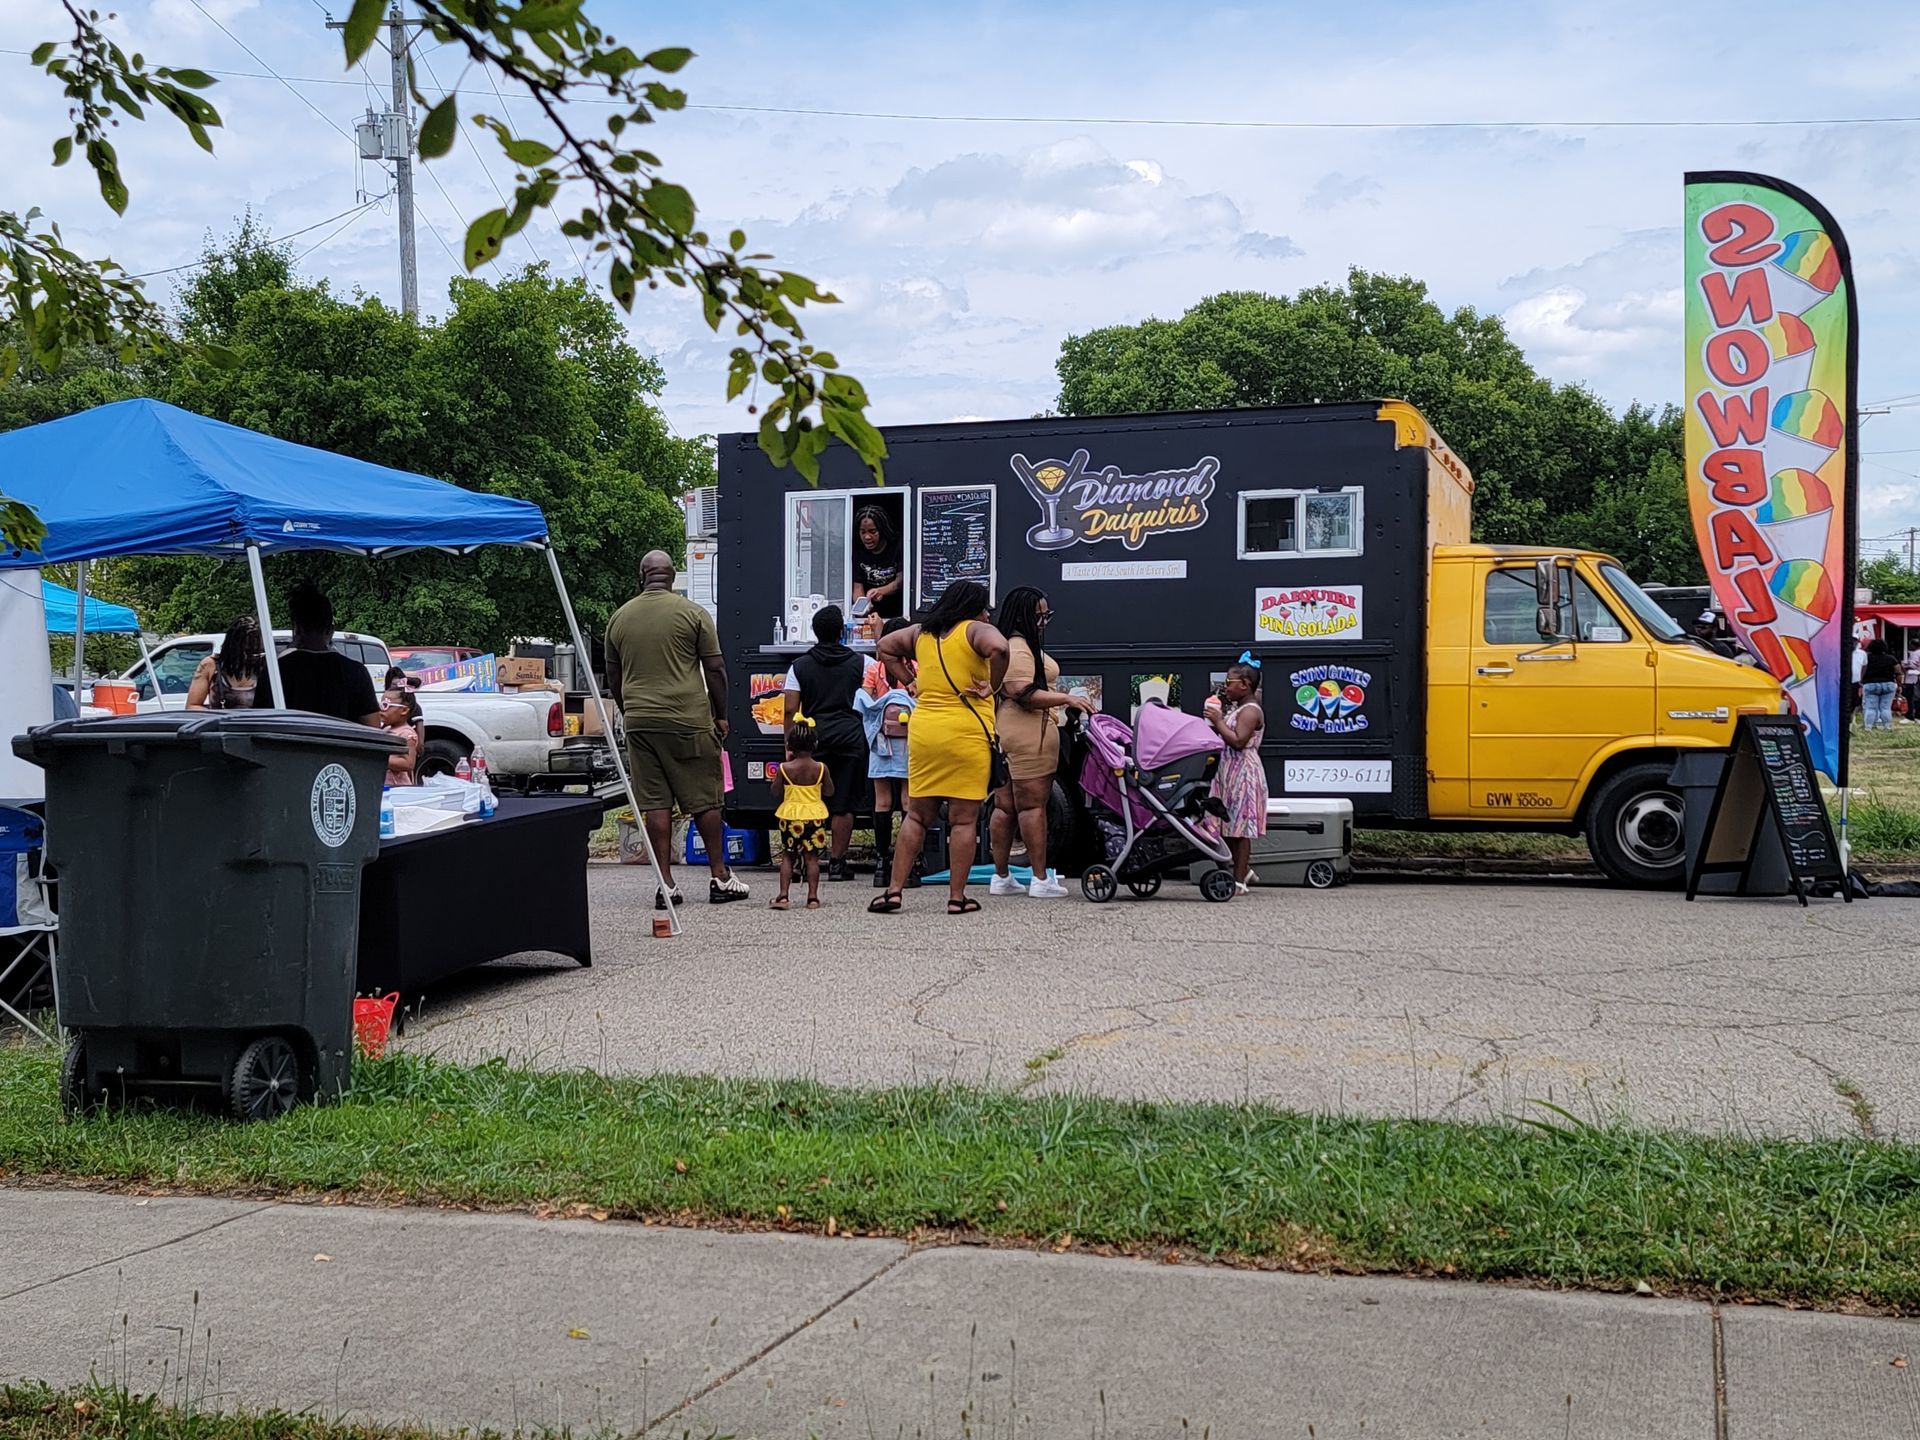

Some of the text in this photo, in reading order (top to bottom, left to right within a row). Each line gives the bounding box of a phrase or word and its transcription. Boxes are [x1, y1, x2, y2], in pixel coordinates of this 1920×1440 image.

[1068, 464, 1212, 511] Diamond
[1080, 497, 1201, 543] Daiquiris
[1261, 589, 1356, 611] DAIQUIRI
[1298, 612, 1358, 637] COLADA
[516, 671, 543, 681] Sunkist
[1290, 664, 1372, 688] SNOW CONES
[1287, 768, 1392, 783] 937-739-6111
[1486, 792, 1513, 806] GVW
[1517, 797, 1553, 807] 10000
